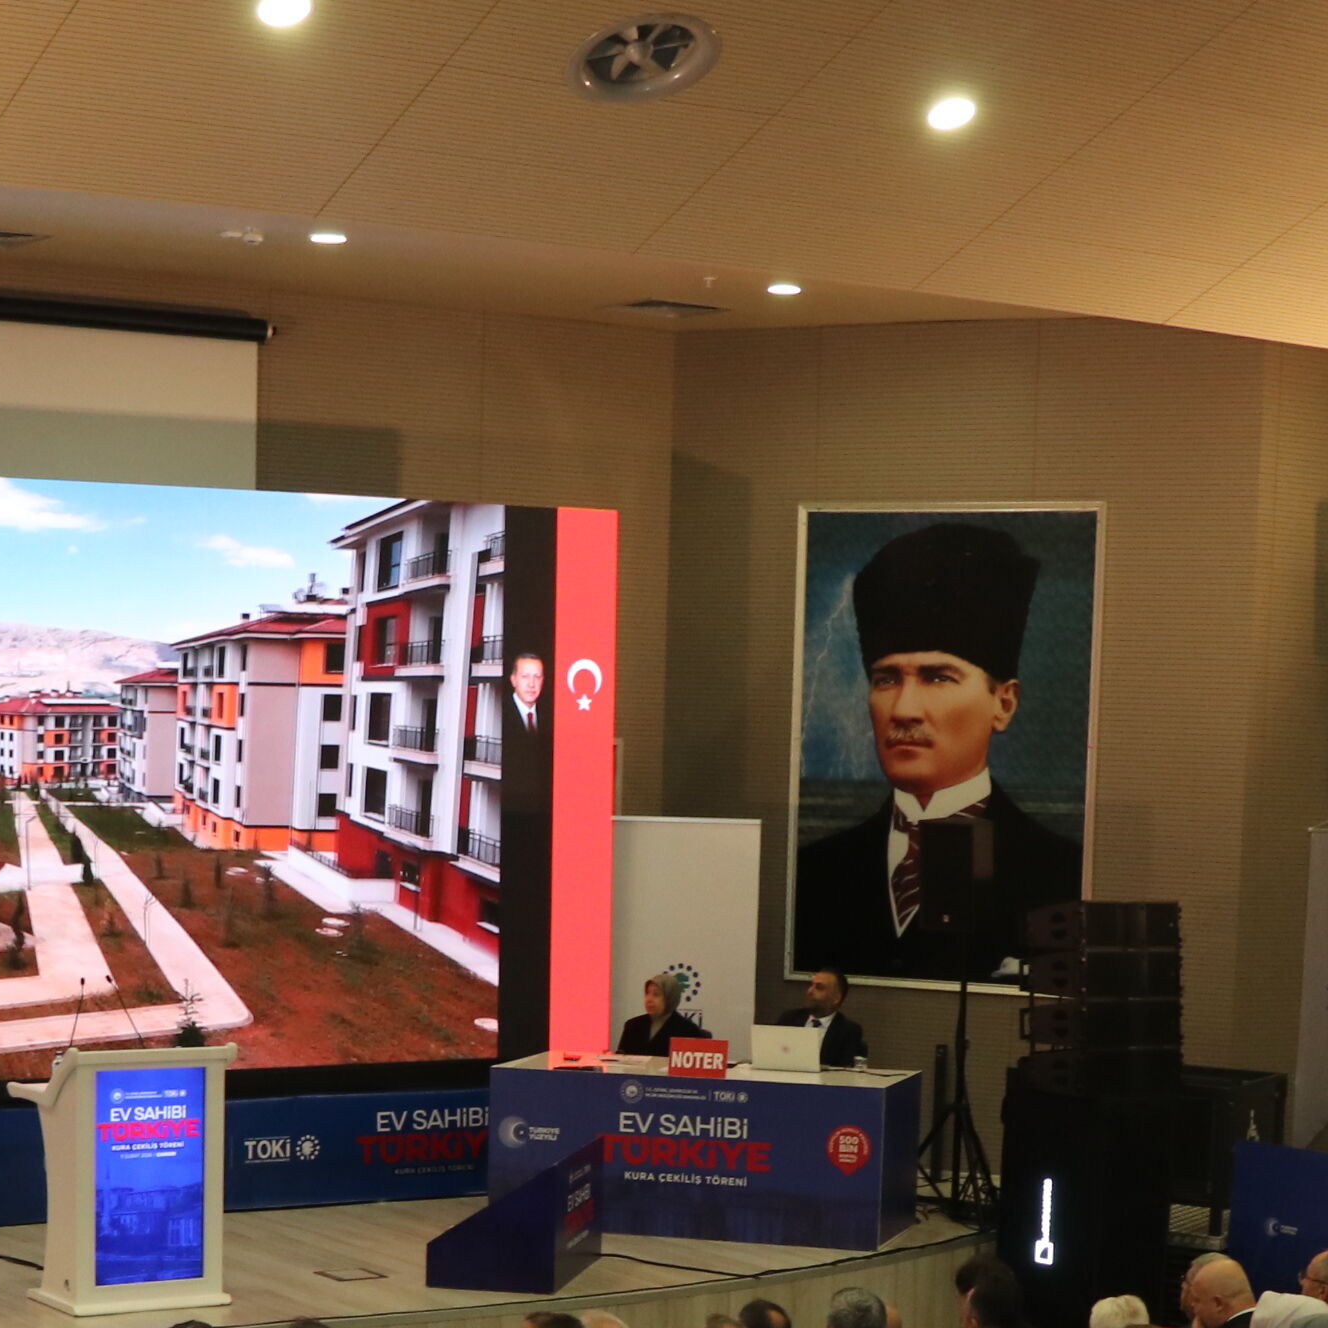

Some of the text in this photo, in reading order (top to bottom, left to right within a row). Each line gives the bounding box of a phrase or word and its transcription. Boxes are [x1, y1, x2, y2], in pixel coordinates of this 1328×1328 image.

[672, 1051, 724, 1070] NOTER
[110, 1107, 132, 1122] EV
[376, 1110, 408, 1132] EV
[619, 1111, 654, 1133] EV
[839, 1135, 859, 1145] 500
[624, 1171, 747, 1187] KURA ÇEKİLİŞ TÖRENİ
